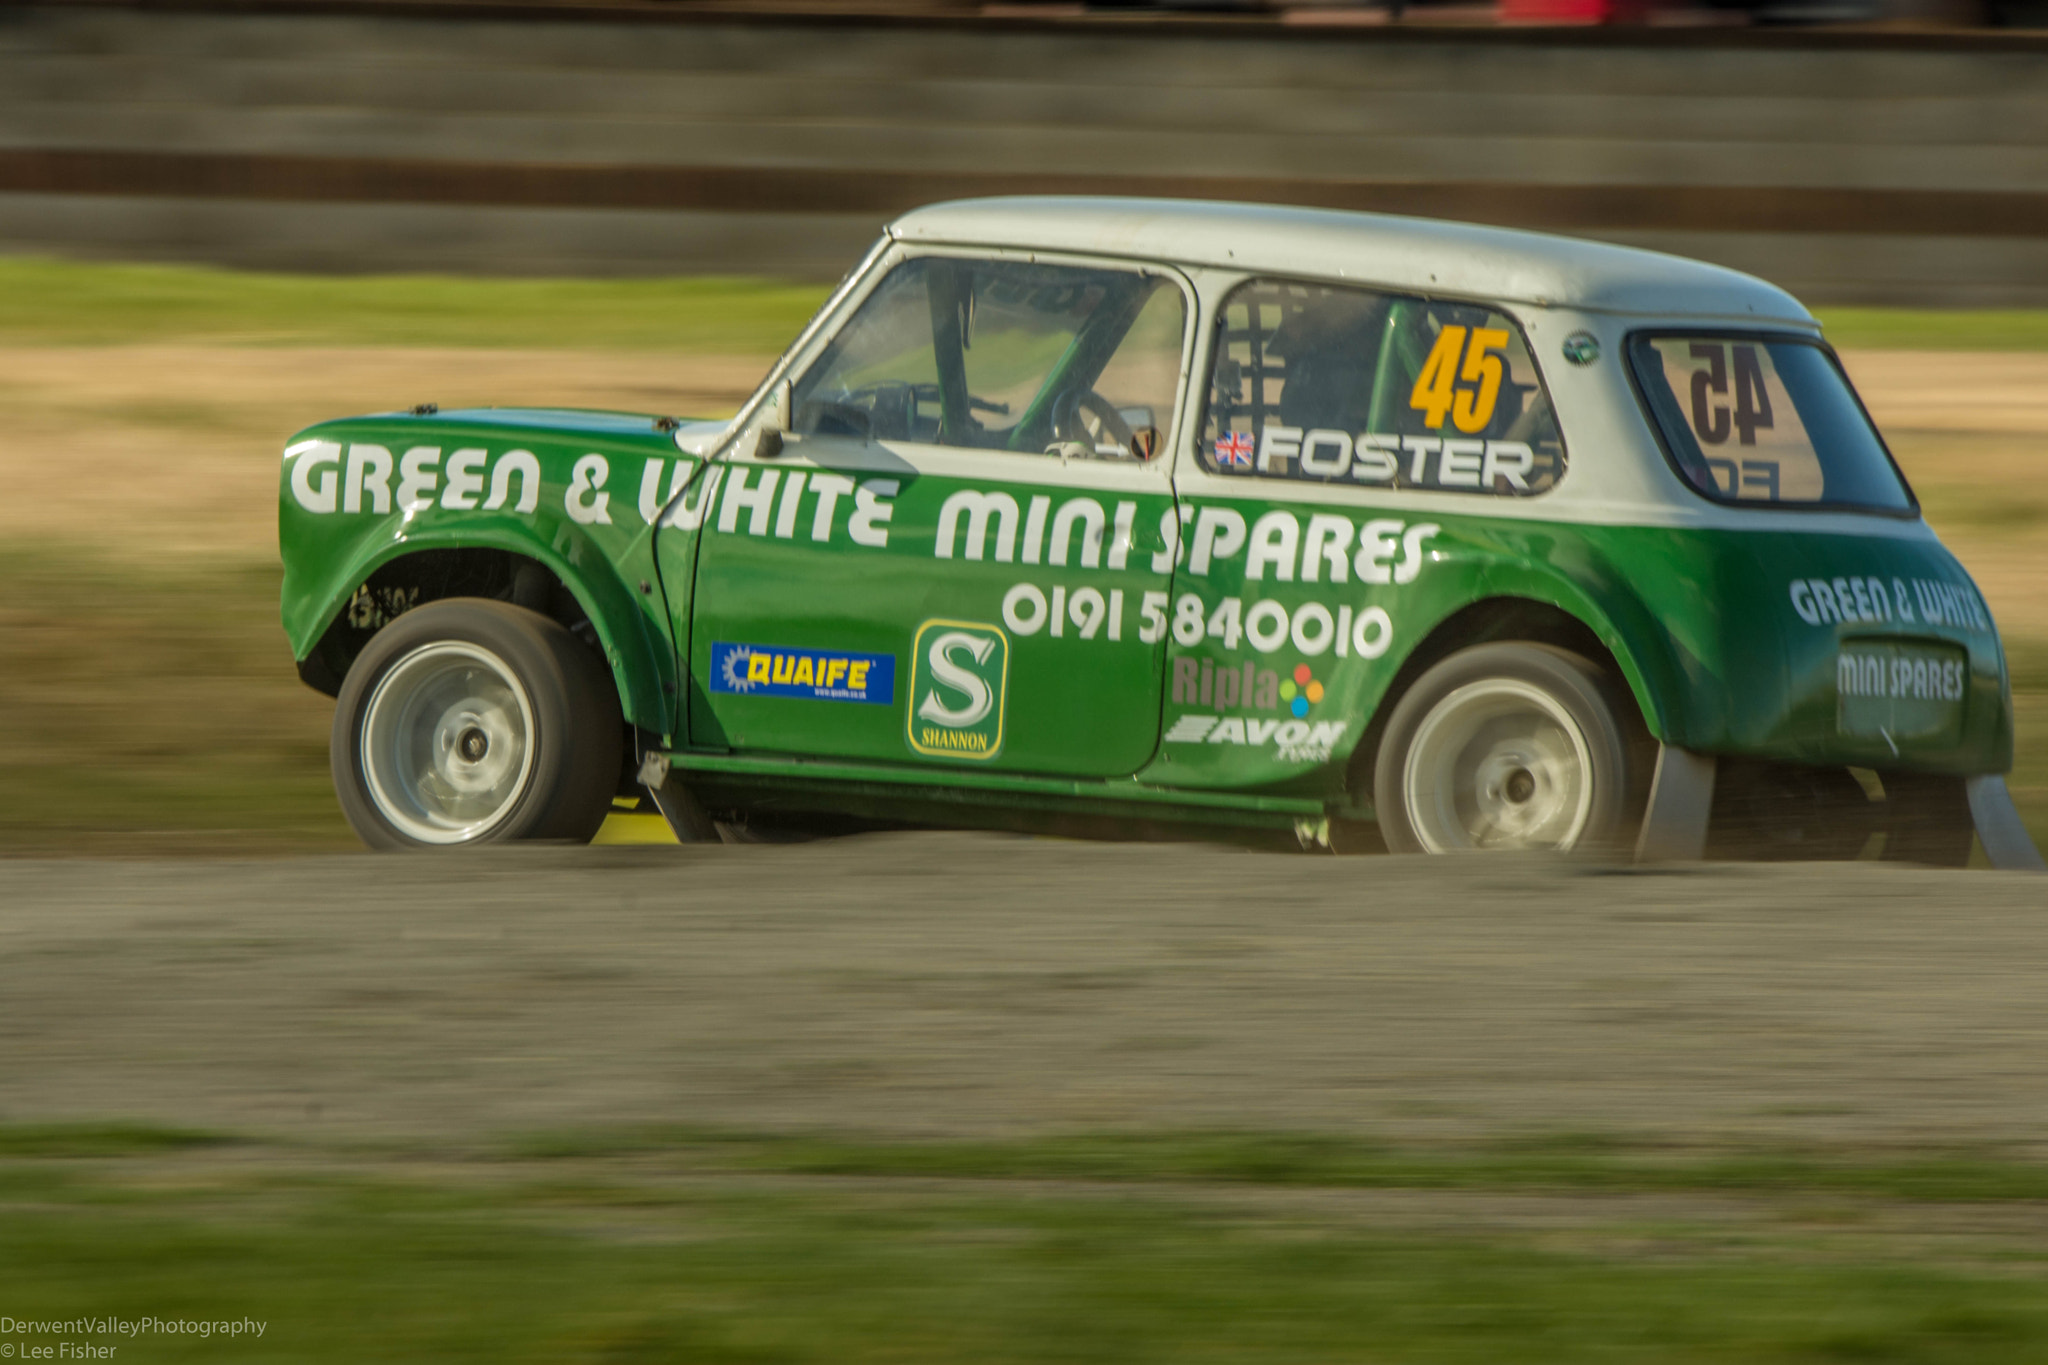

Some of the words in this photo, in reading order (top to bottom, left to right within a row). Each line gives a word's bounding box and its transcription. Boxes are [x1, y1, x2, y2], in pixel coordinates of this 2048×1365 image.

[1410, 324, 1510, 434] 45
[1257, 425, 1535, 490] FOSTER
[291, 441, 541, 515] GREEN
[564, 453, 613, 525] &
[638, 457, 900, 548] WHITE
[934, 489, 1137, 571] MINI
[1151, 504, 1440, 585] SPARES
[1001, 582, 1124, 642] 0191
[1139, 591, 1394, 660] 5840010
[1789, 575, 1893, 627] GREEN
[1893, 576, 1916, 624] &
[747, 653, 870, 690] QUAIFE
[918, 631, 996, 728] S
[1172, 655, 1279, 713] Ripla
[1837, 653, 1886, 697] MINI
[1890, 657, 1964, 701] SPARES
[921, 726, 988, 753] SHANNON
[1206, 717, 1347, 747] AVON
